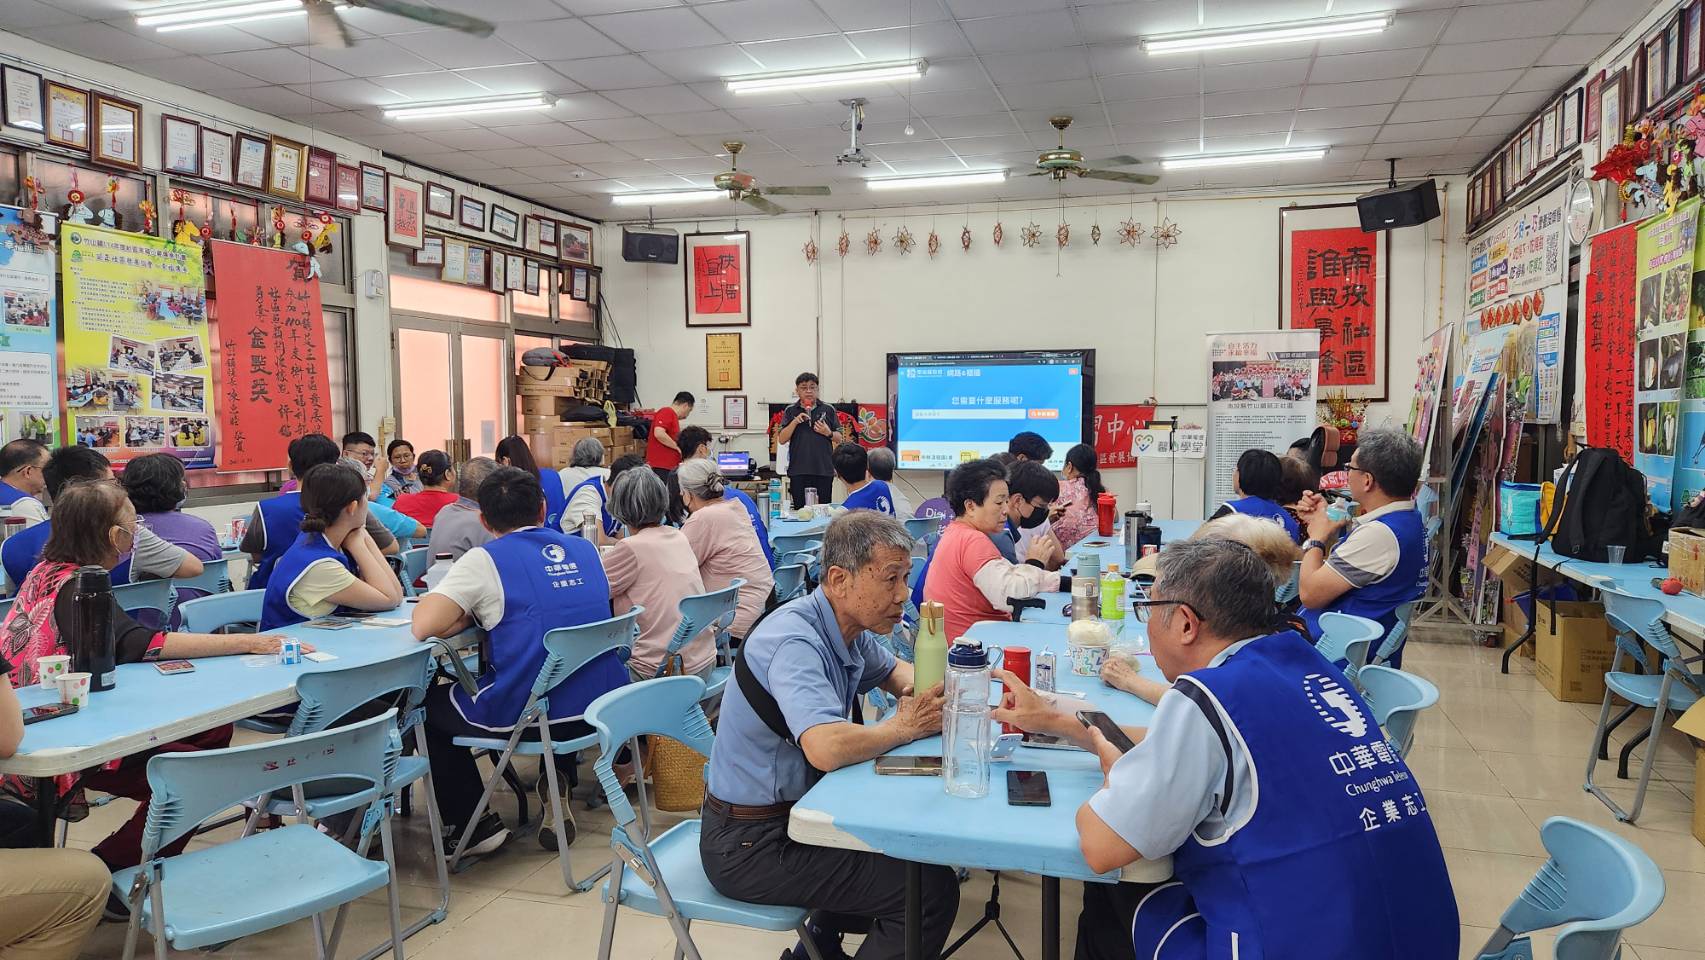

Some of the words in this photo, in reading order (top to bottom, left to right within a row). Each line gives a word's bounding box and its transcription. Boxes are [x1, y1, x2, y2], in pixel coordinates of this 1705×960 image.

[286, 256, 312, 283] 賀
[1337, 247, 1372, 378] 南投社區
[952, 396, 1023, 406] 您需要什麼服務呢?
[544, 562, 577, 572] 中華電信
[552, 577, 584, 588] 企業志工
[1345, 775, 1393, 797] Chunghwa
[1359, 792, 1427, 832] 企業志工
